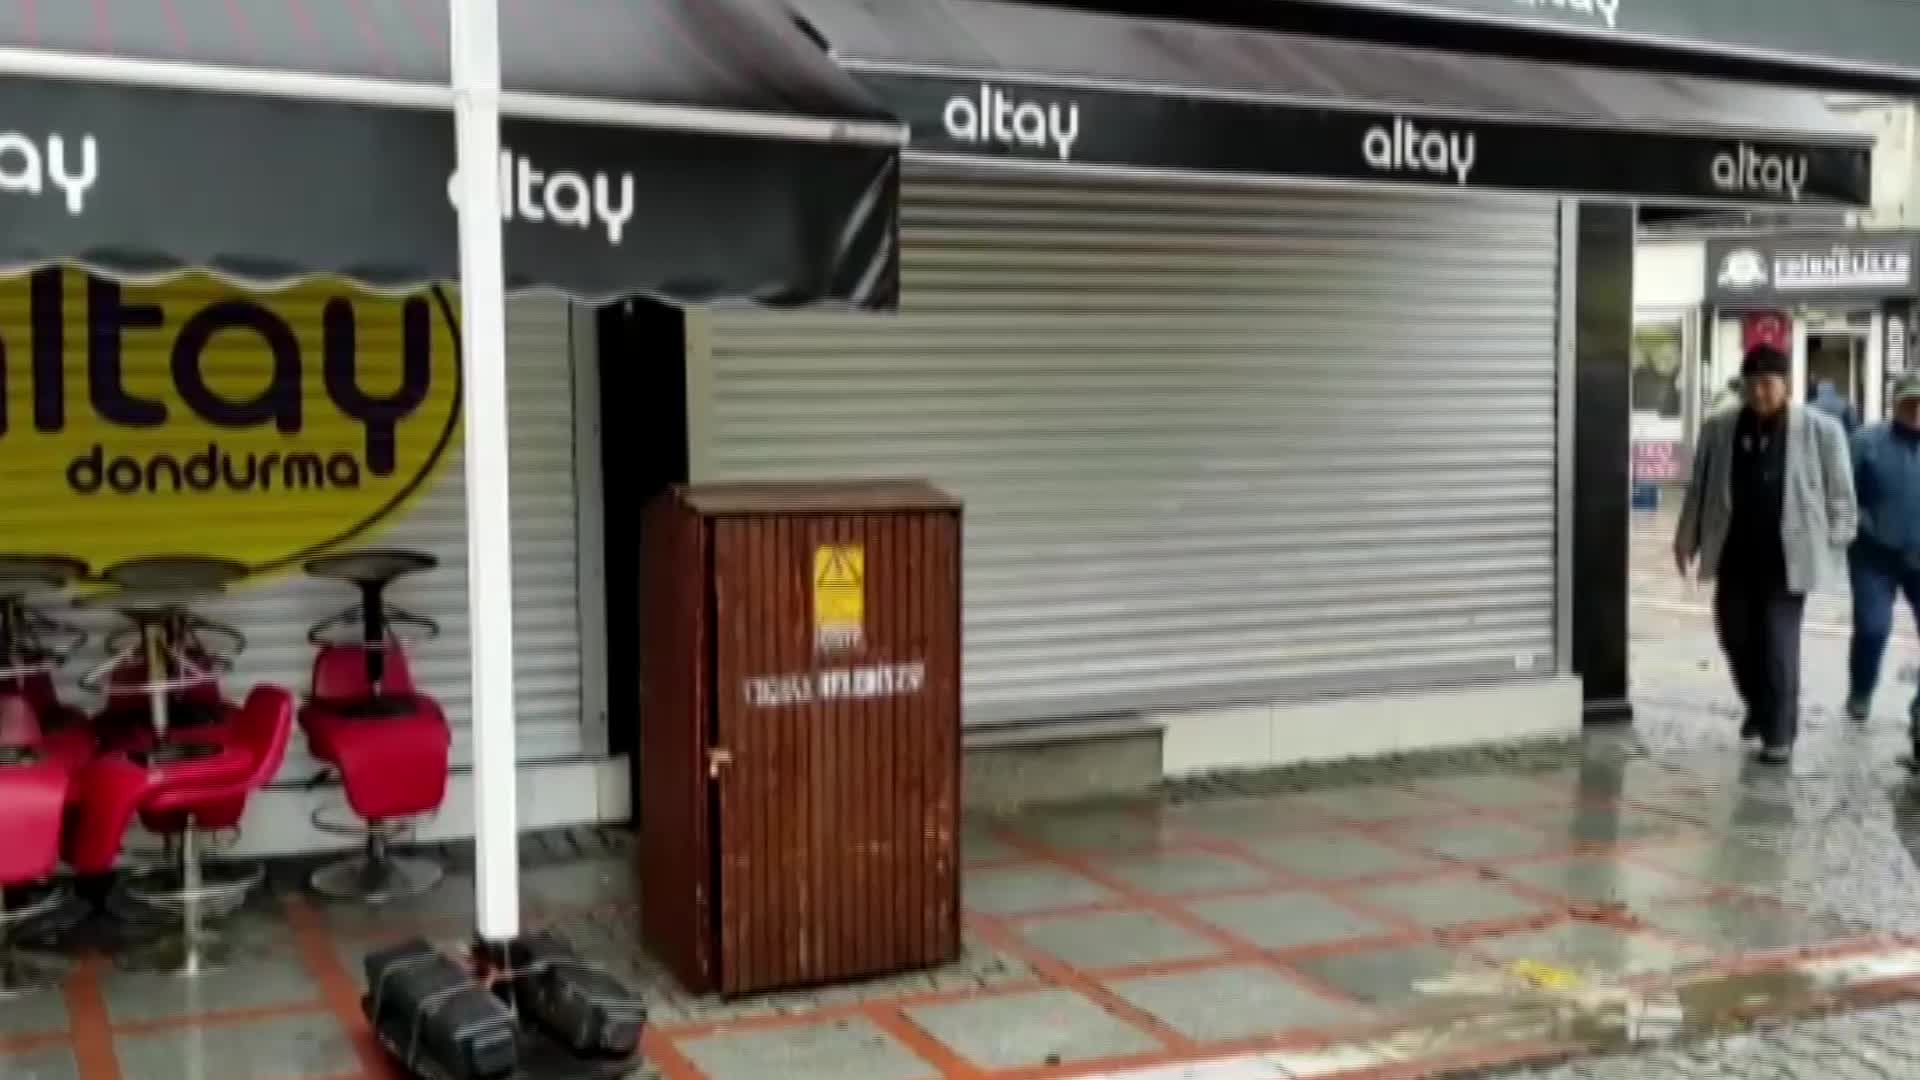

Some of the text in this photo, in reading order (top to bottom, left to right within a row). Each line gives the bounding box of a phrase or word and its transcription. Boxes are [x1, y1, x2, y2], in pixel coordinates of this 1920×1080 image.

[944, 82, 1079, 161] altay
[1363, 115, 1476, 186] altay
[447, 148, 634, 244] ltay
[1710, 141, 1808, 201] altay
[0, 268, 431, 476] ltay
[67, 443, 360, 494] dondurma
